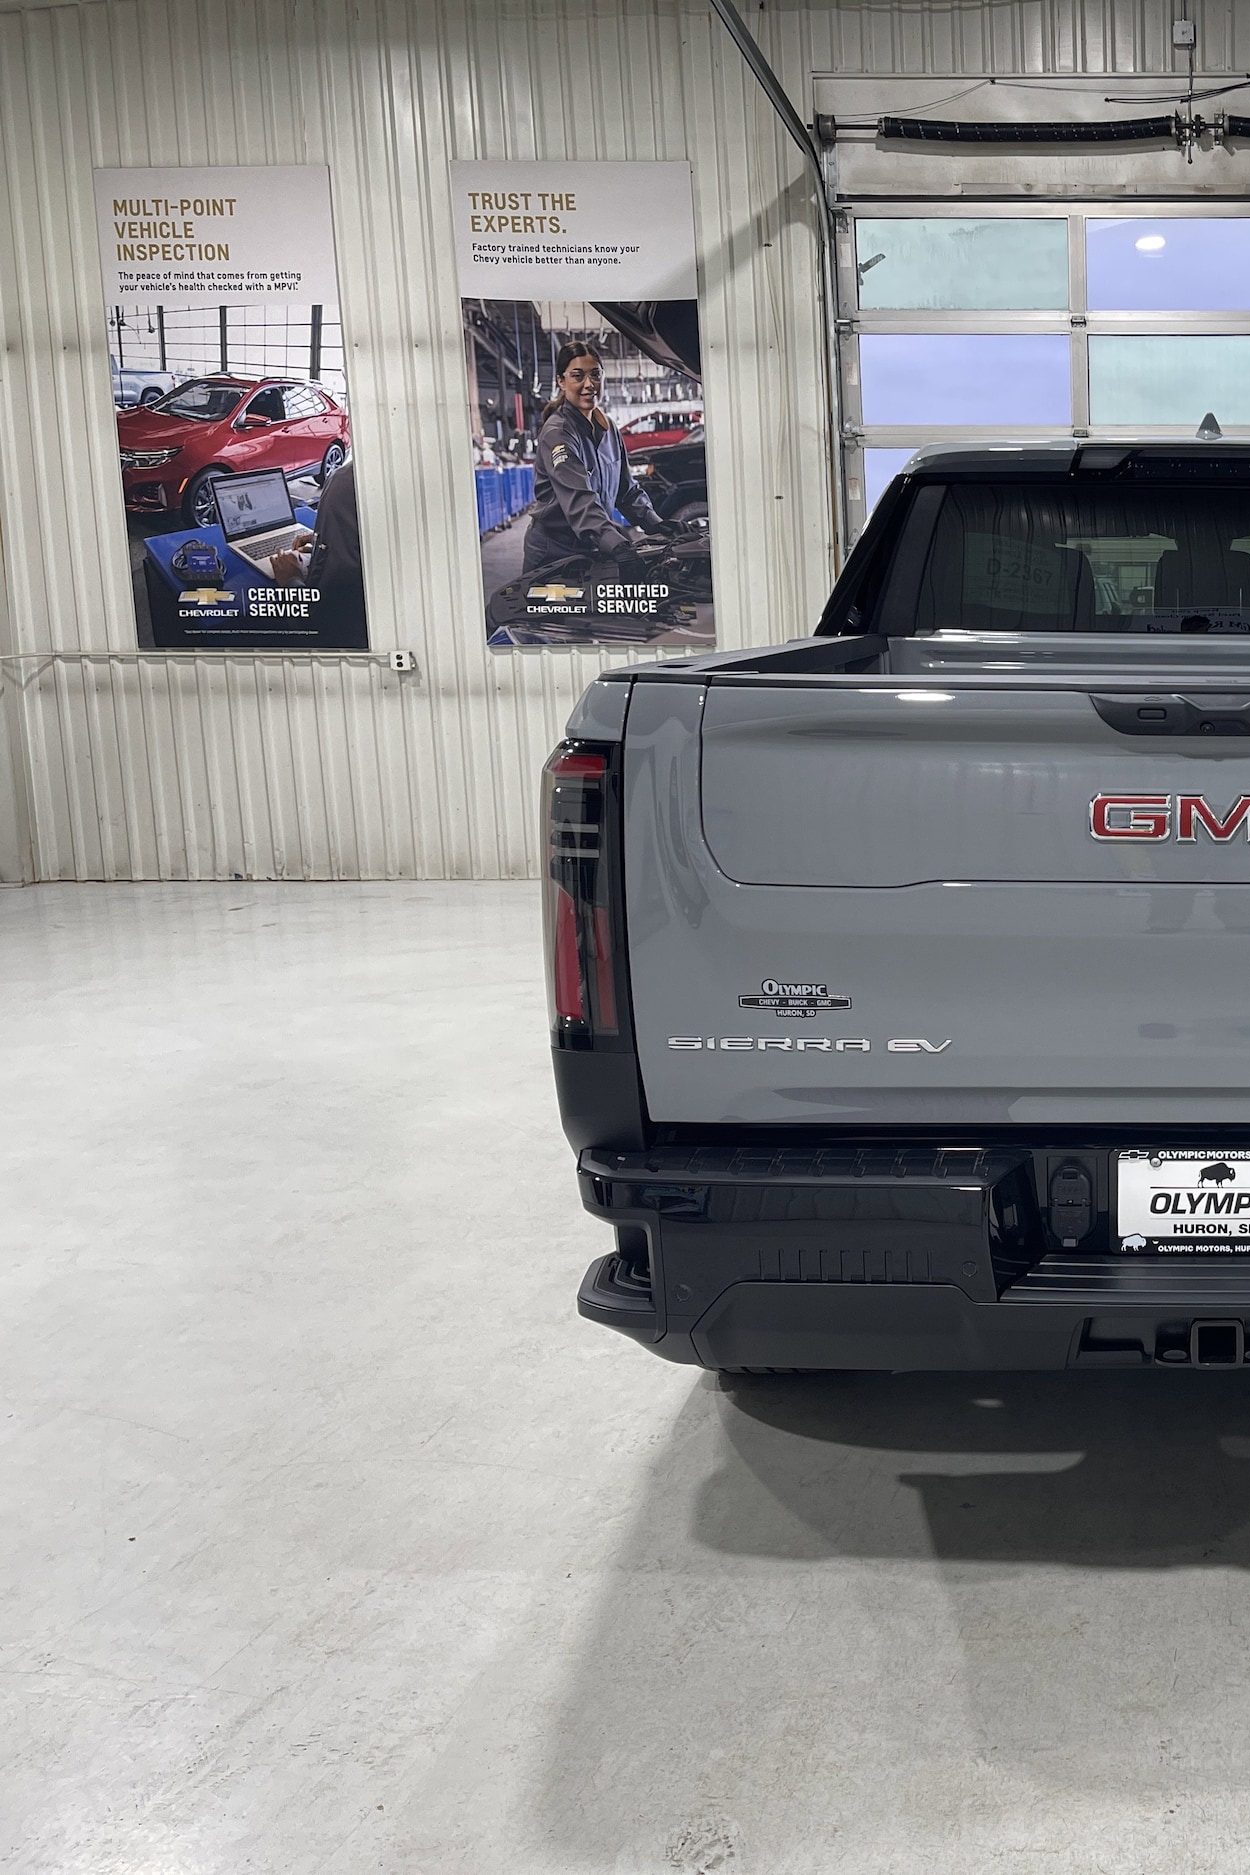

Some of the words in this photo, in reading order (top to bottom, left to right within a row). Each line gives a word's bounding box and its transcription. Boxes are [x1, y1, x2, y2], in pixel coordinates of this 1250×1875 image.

[113, 198, 237, 217] MULTI-POINT
[468, 192, 532, 211] TRUST
[537, 193, 577, 211] THE
[114, 221, 195, 239] VEHICLE
[470, 215, 567, 234] EXPERTS.
[116, 243, 230, 262] INSPECTION
[472, 242, 506, 254] Factory
[508, 243, 540, 253] trained
[542, 244, 593, 253] technicians
[594, 244, 618, 253] know
[619, 245, 640, 255] your
[473, 254, 500, 265] Chevy
[502, 255, 533, 264] vehicle
[535, 255, 563, 264] better
[565, 256, 585, 265] than
[587, 257, 621, 266] anyone.
[118, 271, 134, 280] The
[136, 272, 161, 282] peace
[163, 270, 171, 280] of
[173, 271, 195, 280] mind
[196, 271, 215, 280] that
[246, 270, 268, 280] from
[269, 271, 301, 282] getting
[119, 284, 139, 293] your
[140, 282, 177, 291] vehicle's
[178, 282, 206, 291] health
[207, 282, 243, 291] checked
[245, 282, 264, 291] with
[248, 587, 320, 602] CERTIFIED
[597, 584, 669, 598] CERTIFIED
[178, 609, 239, 617] CHEVROLET
[249, 603, 310, 618] SERVICE
[526, 605, 588, 614] CHEVROLET
[597, 600, 658, 614] SERVICE
[762, 979, 827, 996] OLYMPIC
[777, 1009, 805, 1018] HURON,
[806, 1009, 816, 1017] SD
[667, 1035, 871, 1052] SIERRA
[887, 1038, 952, 1053] EV
[1173, 1223, 1233, 1236] HURON,
[1157, 1244, 1194, 1253] OLYMPIC
[1195, 1244, 1233, 1254] MOTORS,
